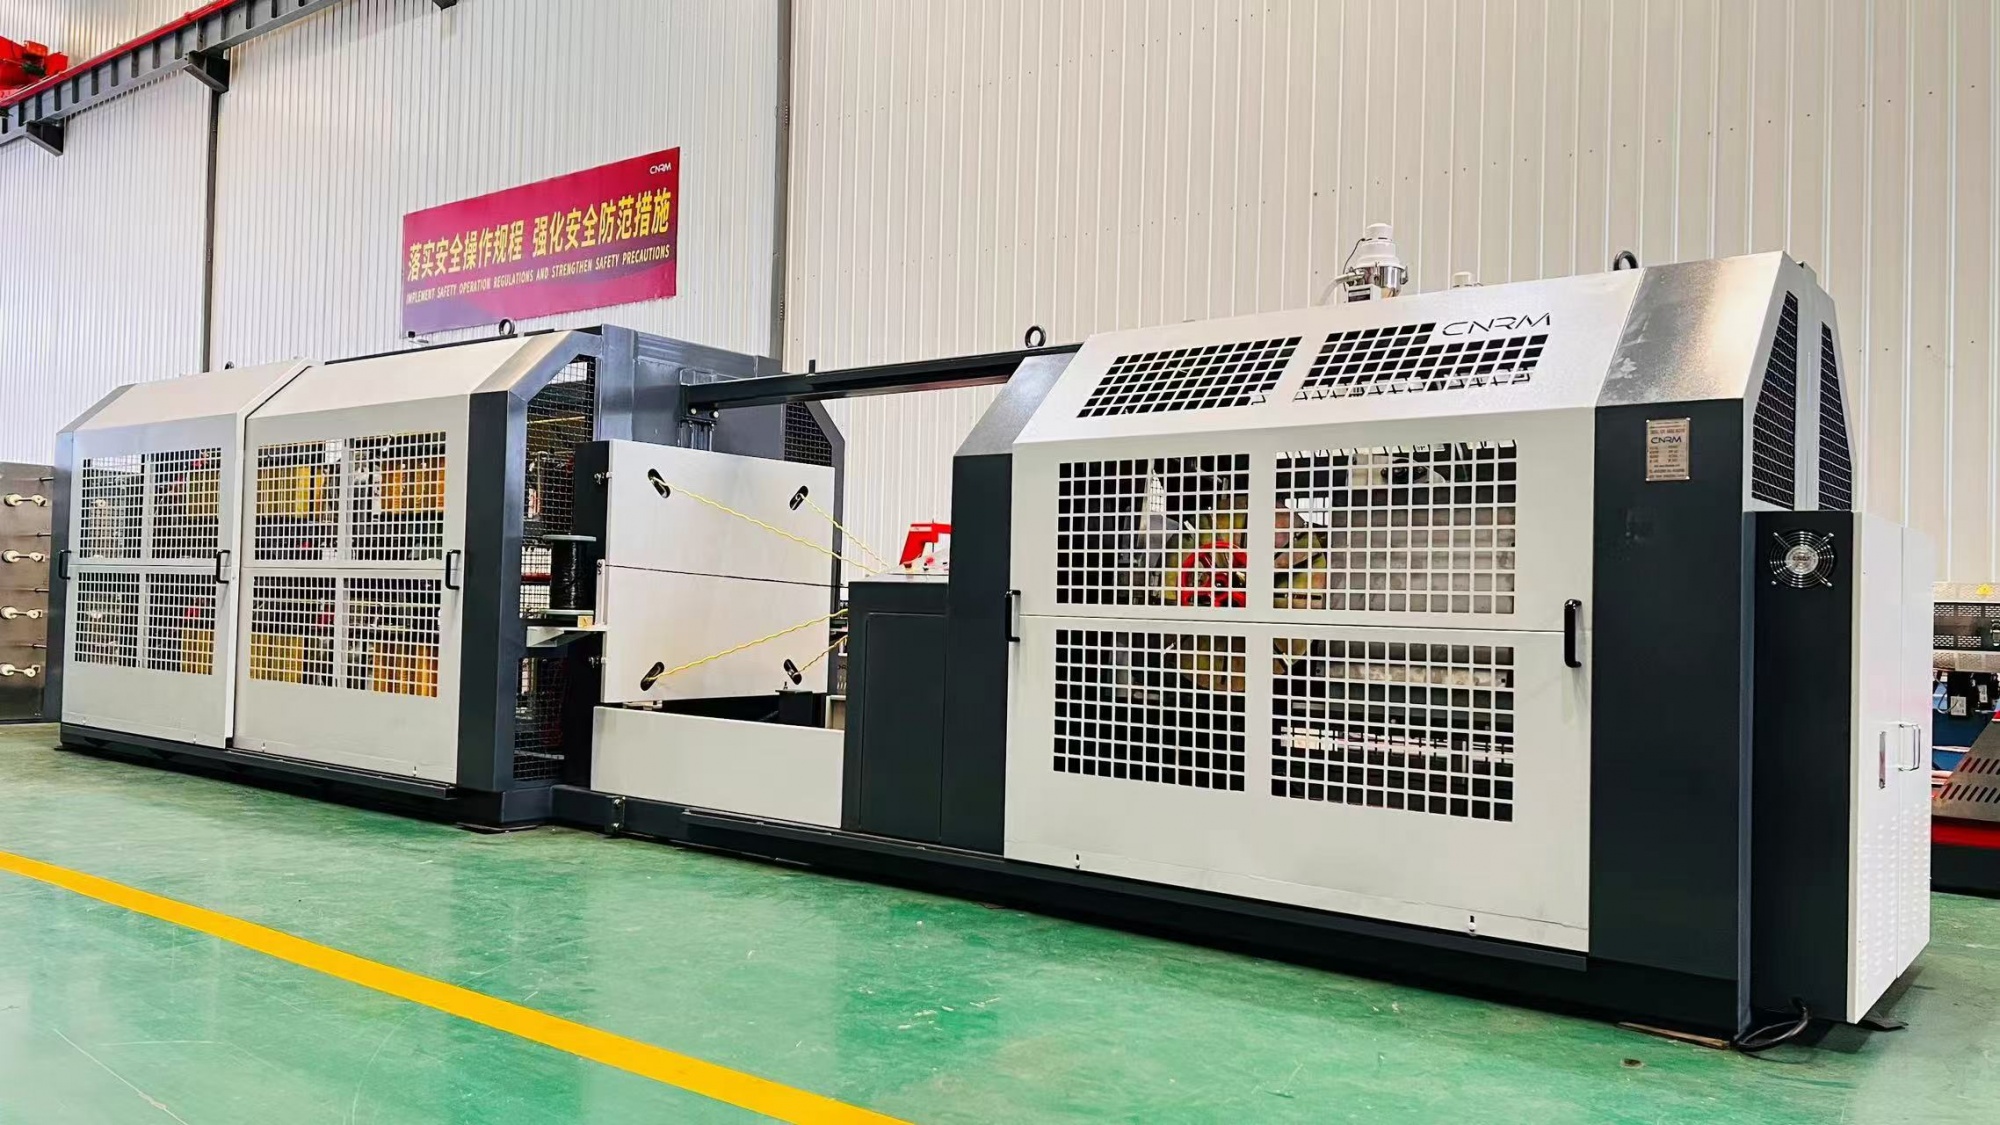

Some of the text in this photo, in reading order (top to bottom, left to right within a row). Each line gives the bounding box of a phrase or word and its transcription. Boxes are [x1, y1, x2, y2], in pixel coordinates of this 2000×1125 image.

[650, 162, 672, 174] CNRM
[407, 187, 671, 281] 落实安全操作规程 强化安全防范措施
[406, 244, 670, 304] IMPLEMENT SAFETY OPERATION REGULATIONS AND STRENGTHEN SAFETY PRECAUTIONS
[1442, 312, 1551, 336] CNRM
[1651, 436, 1682, 444] CNRM
